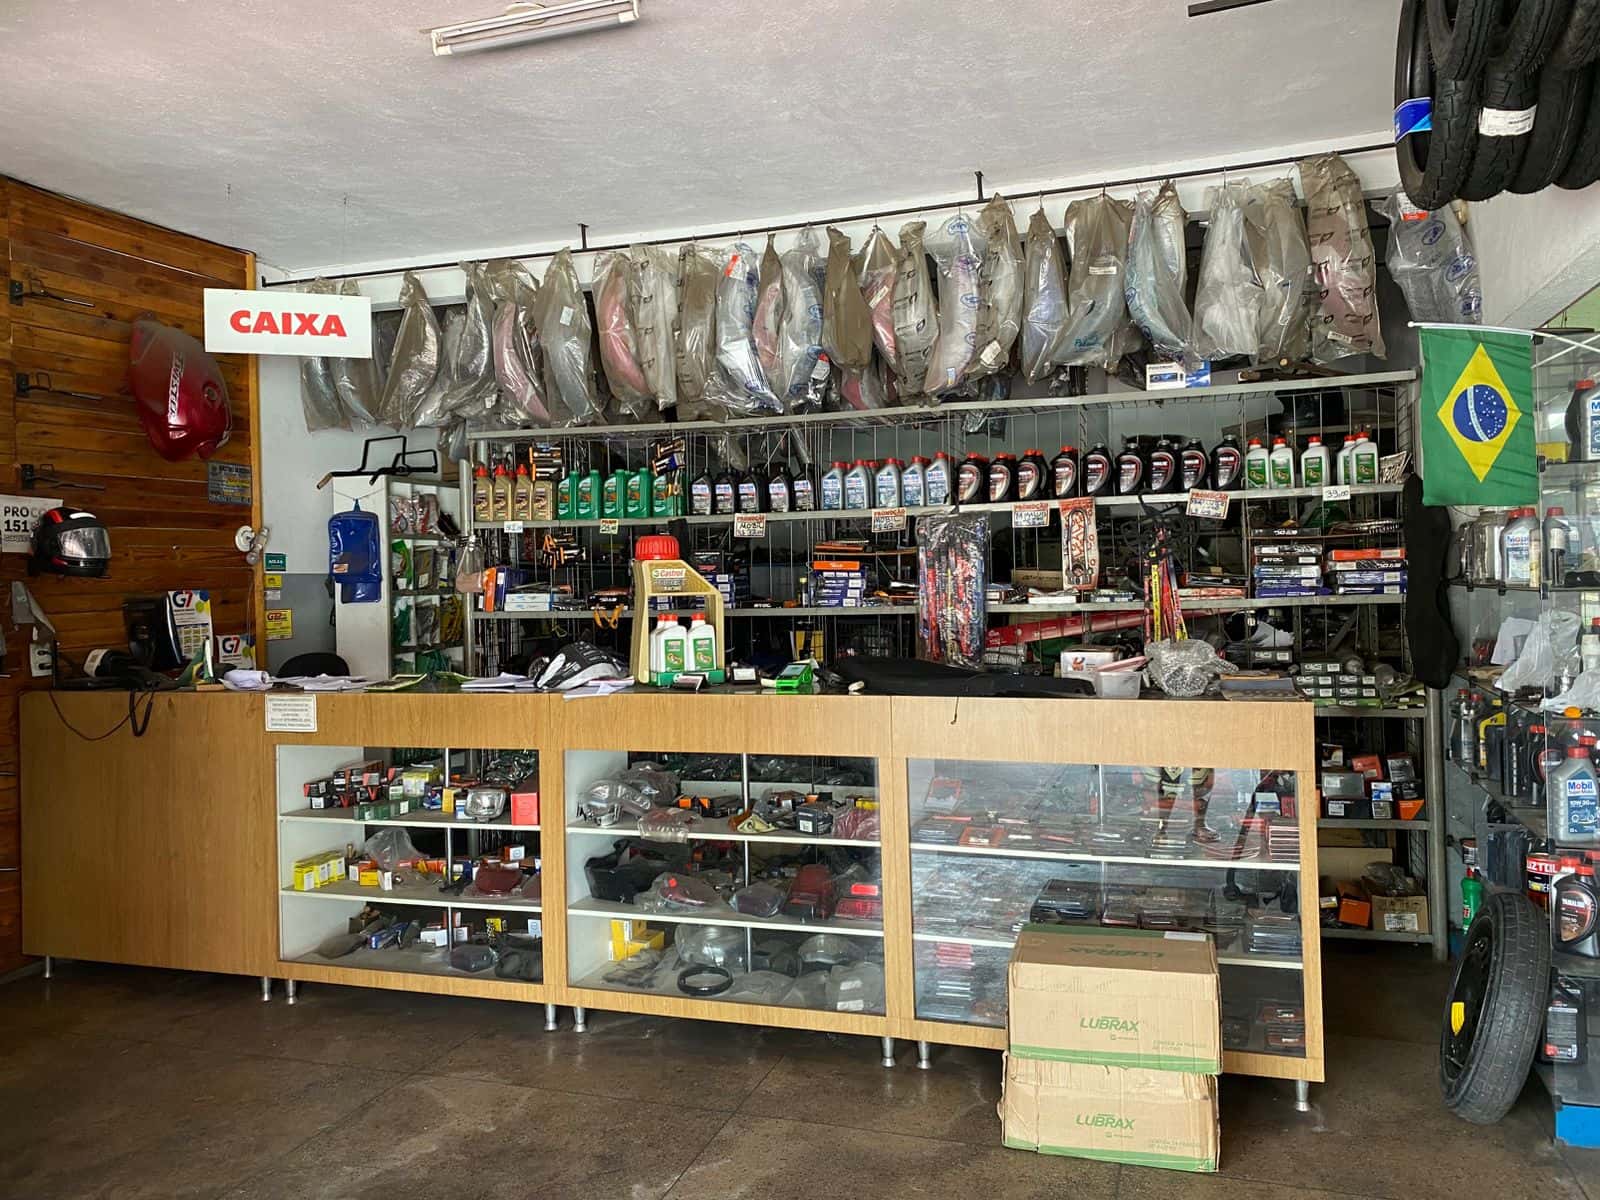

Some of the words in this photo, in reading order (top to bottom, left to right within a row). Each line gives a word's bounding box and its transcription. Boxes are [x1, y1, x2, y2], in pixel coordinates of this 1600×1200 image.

[229, 309, 348, 337] CAIXA
[4, 519, 30, 532] 151
[661, 569, 684, 577] Castrol
[172, 591, 193, 607] G7
[222, 637, 240, 653] G7
[1568, 781, 1593, 790] Mobil
[1080, 1015, 1139, 1032] LUBRAX
[1076, 1113, 1136, 1131] LUBRAX
